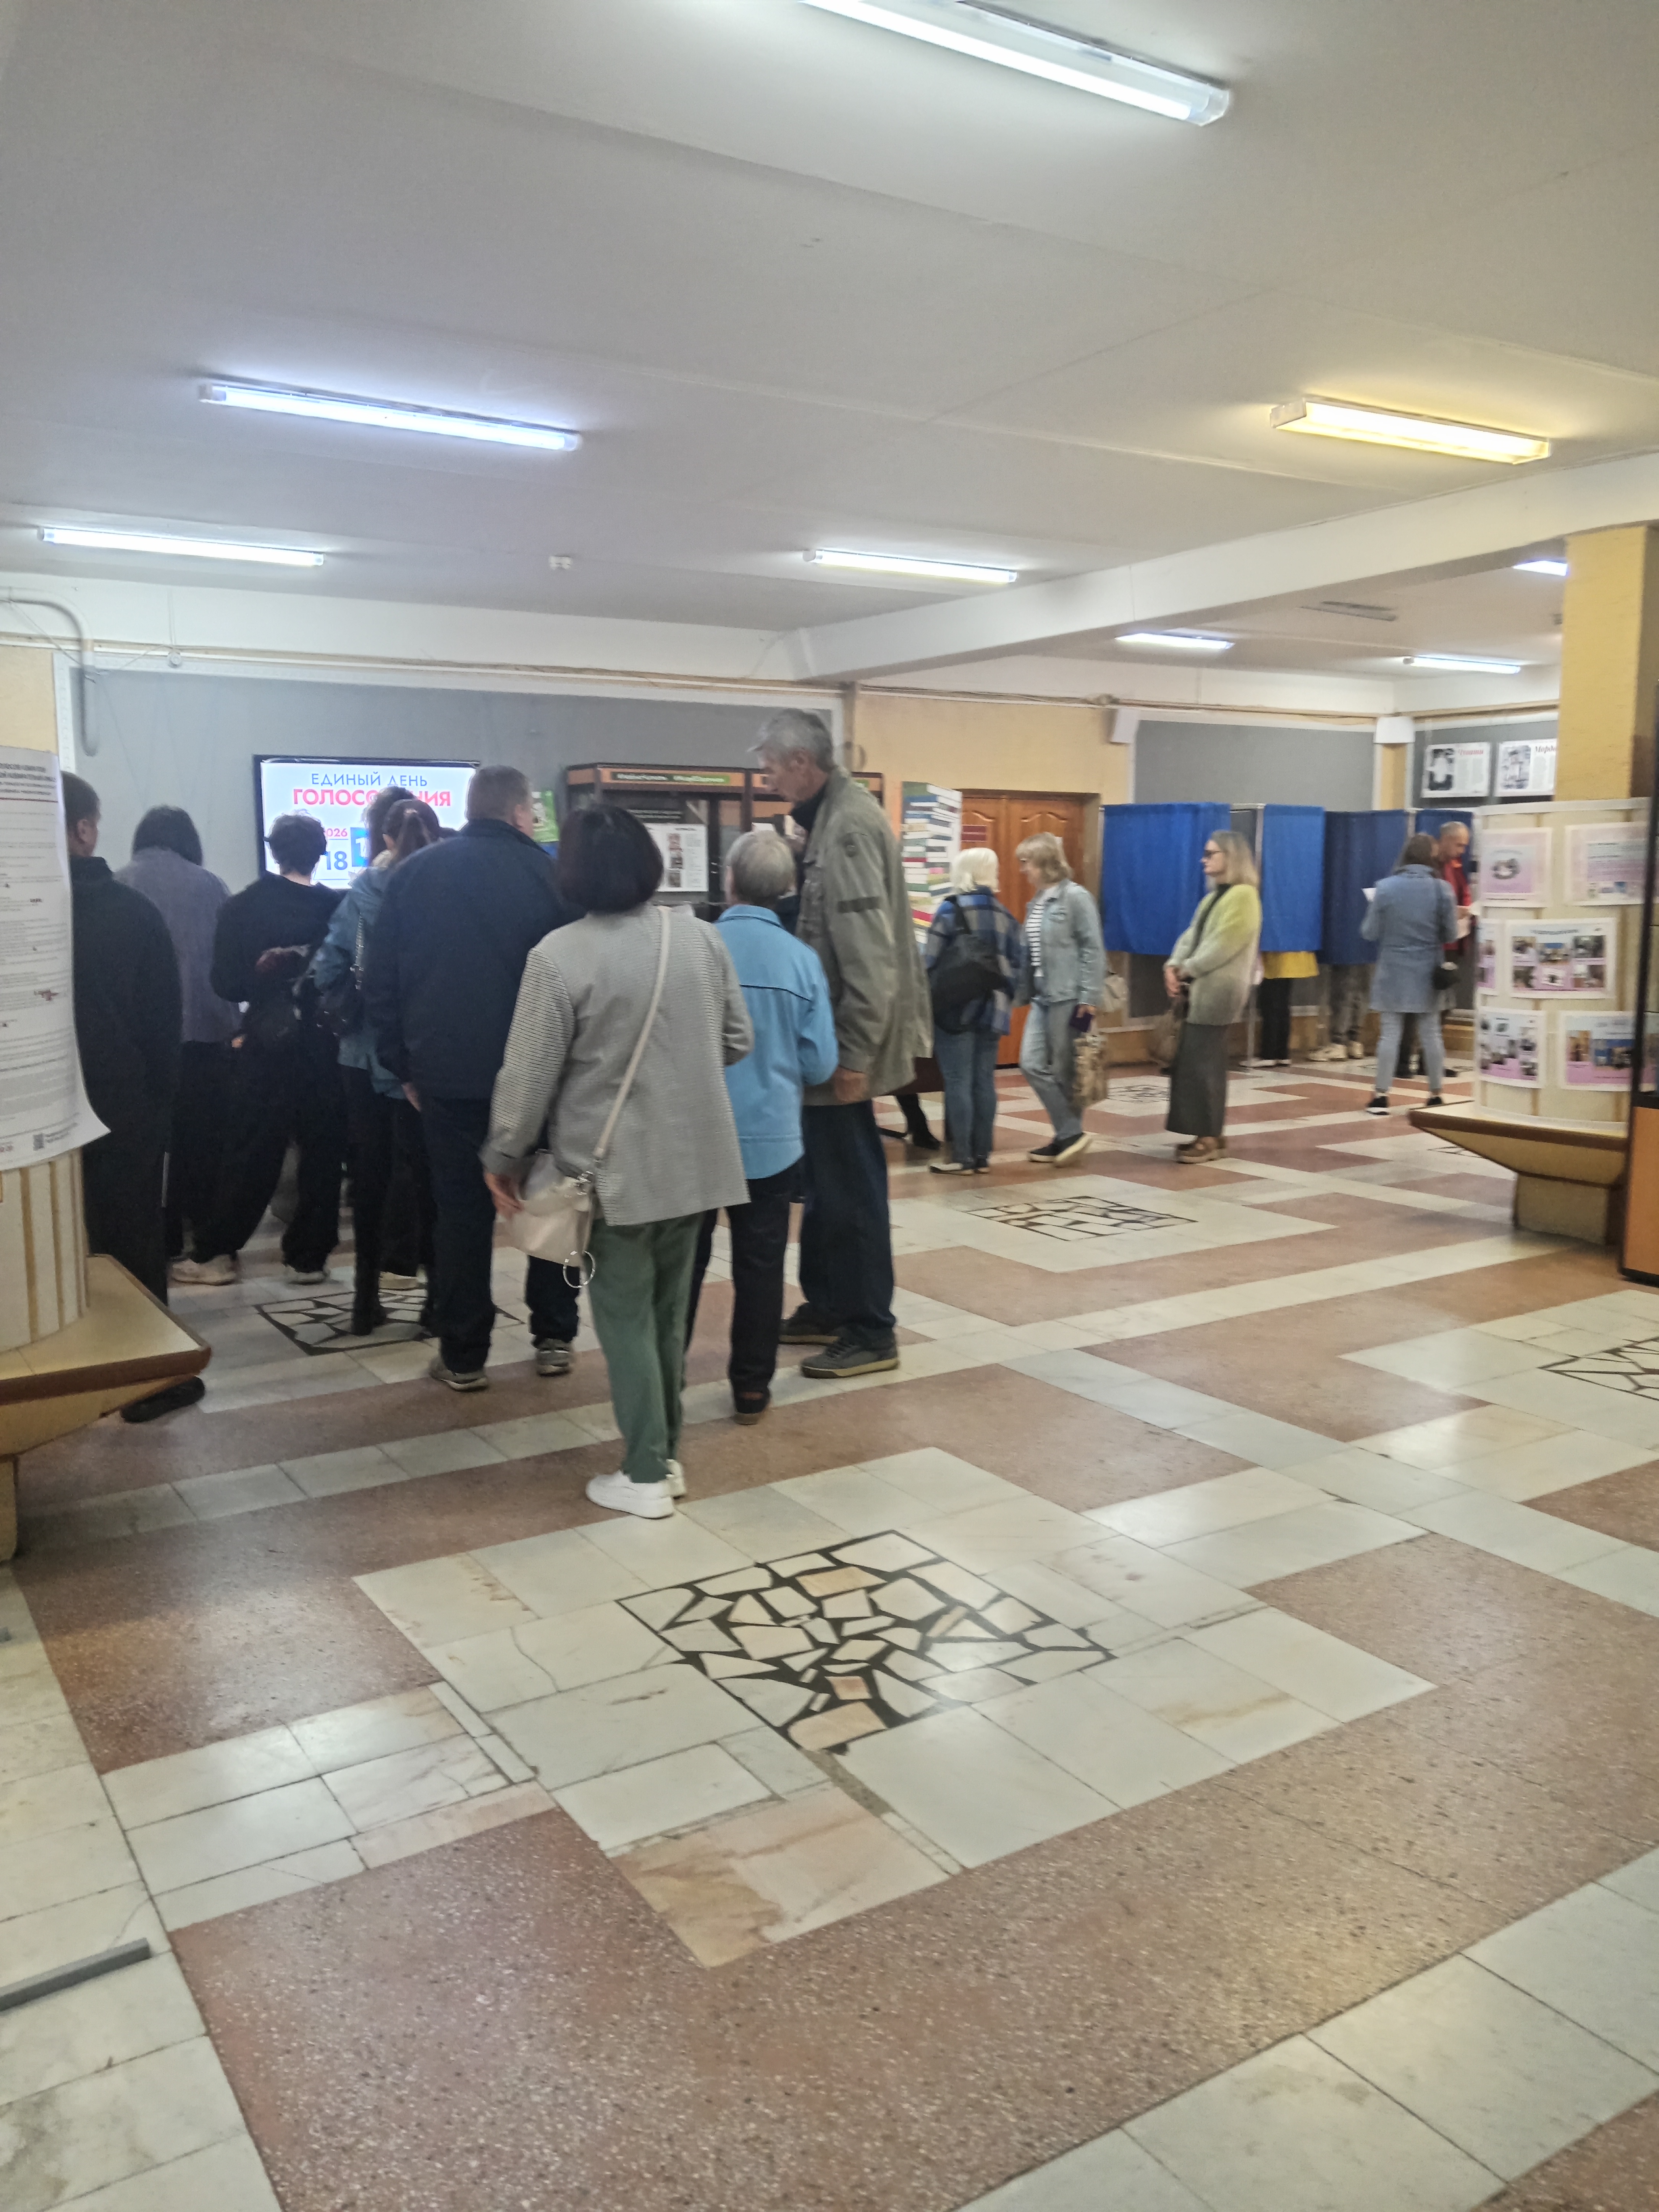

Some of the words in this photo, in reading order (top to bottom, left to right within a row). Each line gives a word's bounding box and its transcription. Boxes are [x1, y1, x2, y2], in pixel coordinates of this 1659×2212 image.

[312, 771, 381, 786] ЕДИНЫЙ
[387, 775, 427, 786] ДЕНЬ
[293, 789, 451, 806] ГОЛОСОНИЯ
[325, 828, 348, 837] 026
